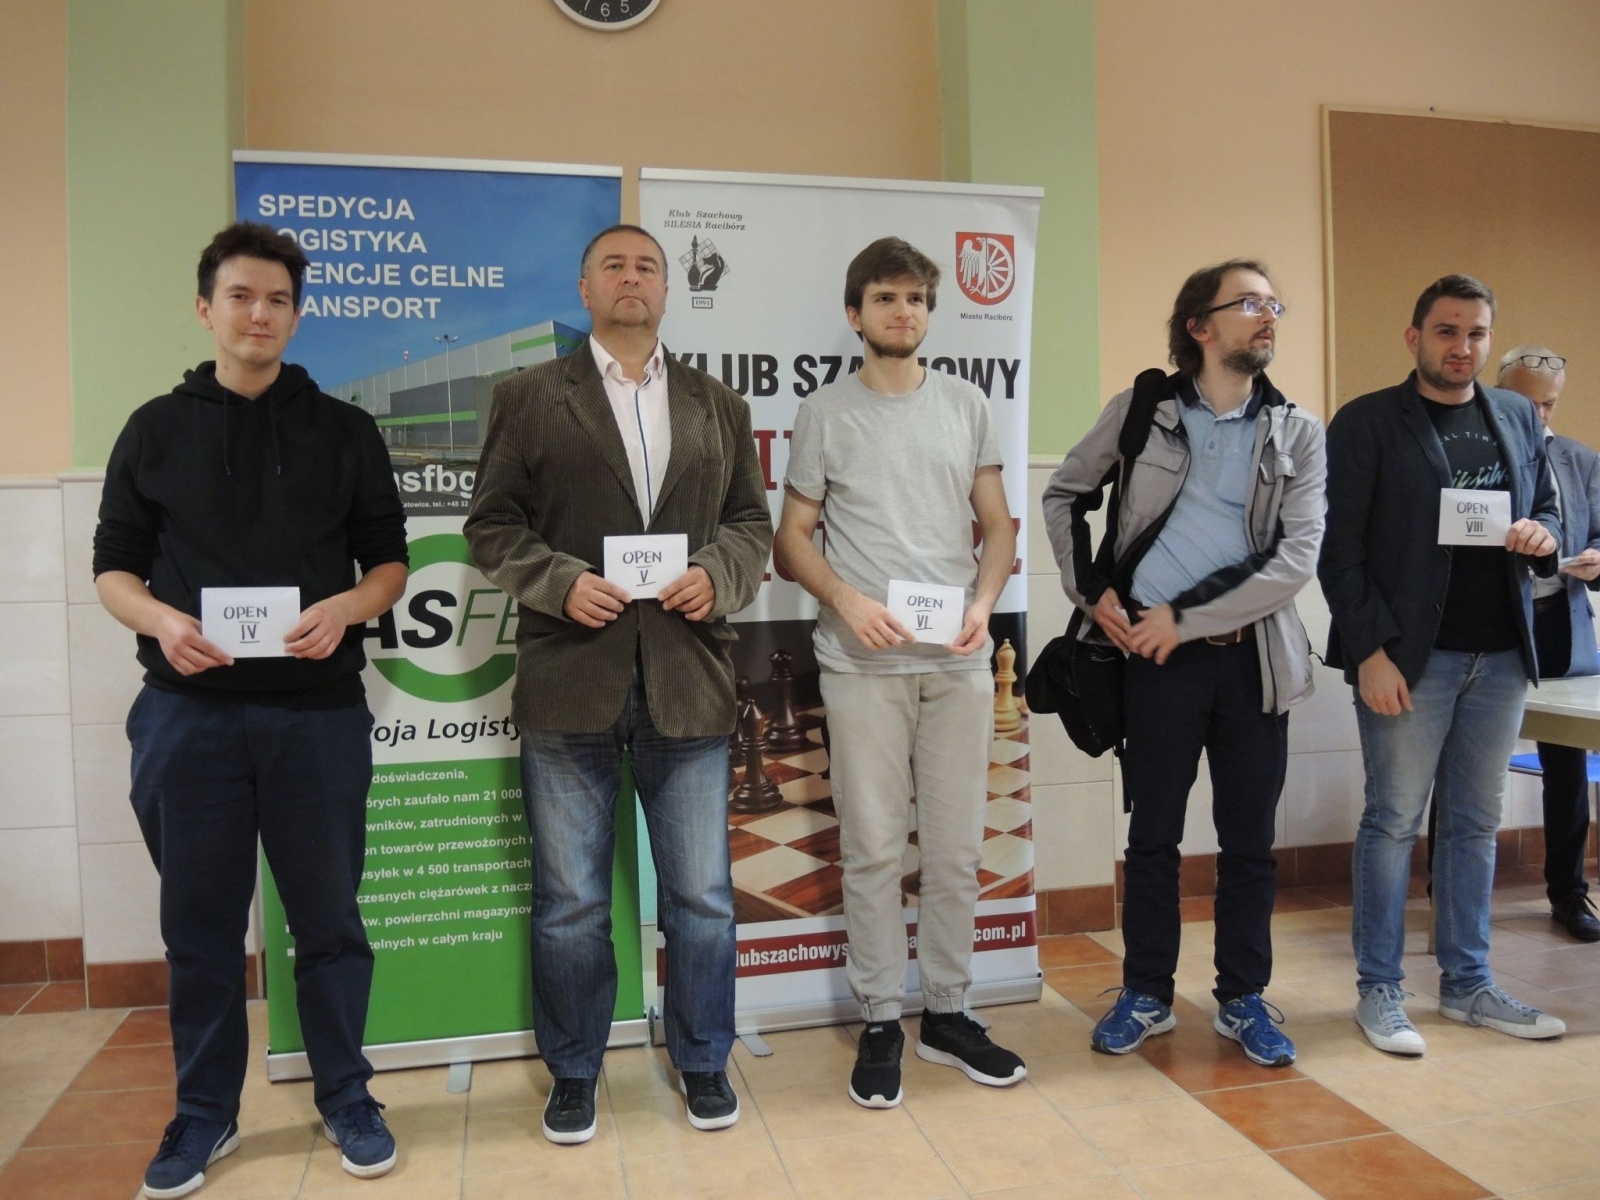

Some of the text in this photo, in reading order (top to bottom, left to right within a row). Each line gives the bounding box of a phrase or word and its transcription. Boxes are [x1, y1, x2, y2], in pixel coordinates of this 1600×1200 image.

[601, 3, 610, 17] 6
[258, 194, 415, 220] SPEDYCJA
[668, 209, 743, 221] Klub Szachowy
[664, 220, 746, 230] SILESIA Racibórz
[302, 262, 504, 287] ENCJE CELNE
[960, 312, 1013, 321] Miasto Racibórz
[1456, 502, 1488, 514] OPEN
[1465, 519, 1485, 535] VIII
[622, 550, 662, 564] OPEN
[906, 595, 943, 609] OPEN
[223, 606, 268, 620] OPEN
[240, 622, 259, 642] IV
[371, 720, 416, 747] oja
[372, 769, 468, 784] doświadczenia,
[404, 793, 449, 806] zaufało
[453, 793, 480, 803] nam
[483, 790, 497, 801] 21
[501, 788, 522, 800] 000
[420, 813, 508, 829] zatrudnionych
[512, 813, 522, 822] w
[381, 842, 434, 855] towarów
[438, 835, 525, 853] przewożonych
[403, 869, 413, 877] w
[417, 865, 424, 876] 4
[428, 863, 450, 875] 500
[453, 858, 531, 874] transportach
[419, 884, 488, 900] ciężarówek
[491, 886, 498, 894] z
[502, 882, 532, 893] nacz
[385, 910, 460, 927] powierzchni
[418, 936, 429, 945] w
[432, 931, 469, 945] całym
[472, 929, 502, 943] kraju
